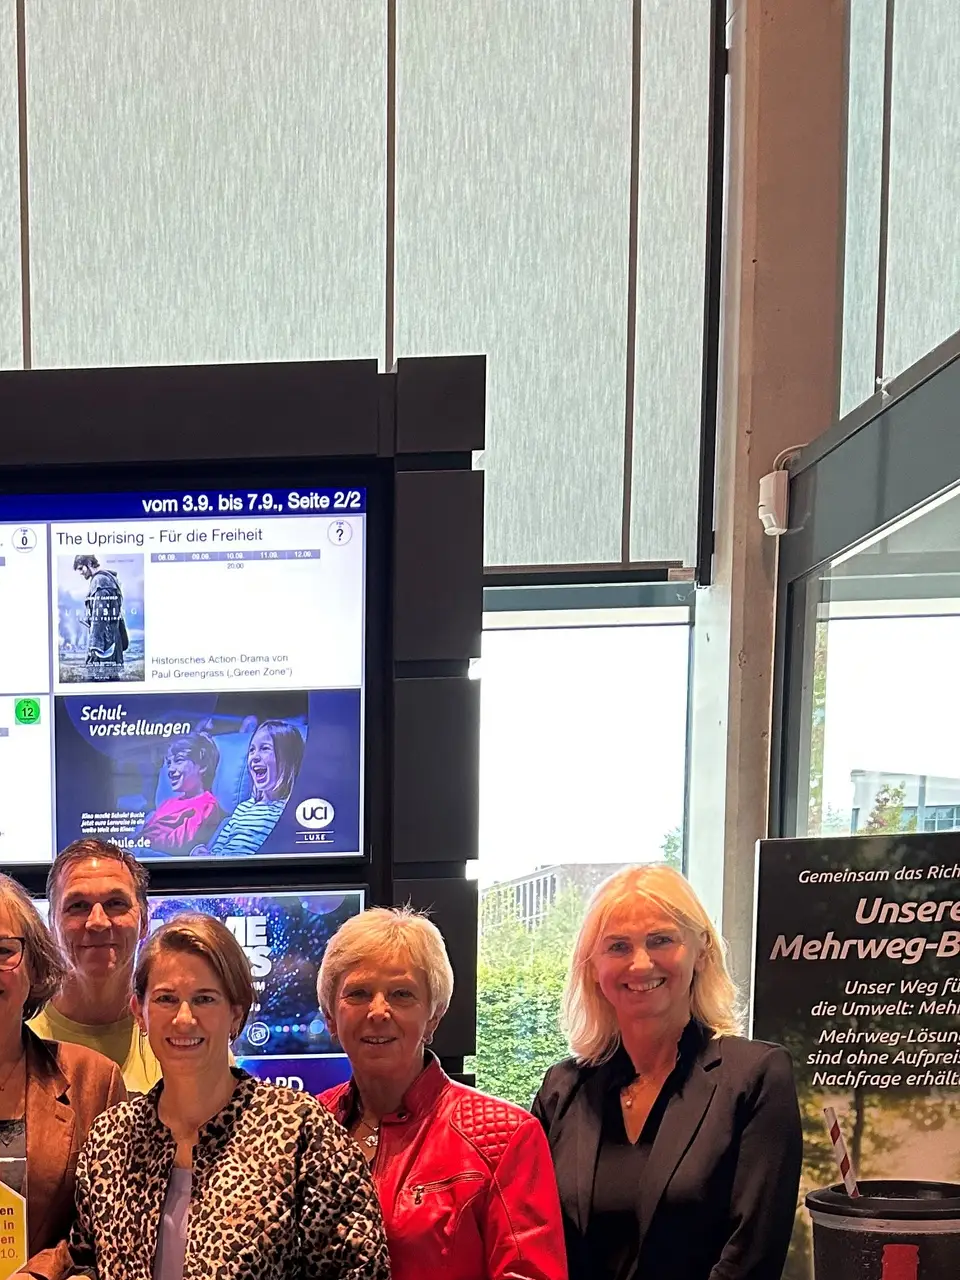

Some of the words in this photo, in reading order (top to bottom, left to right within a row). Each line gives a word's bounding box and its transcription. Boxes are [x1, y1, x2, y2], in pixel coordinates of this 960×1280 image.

[142, 498, 178, 513] vom
[183, 495, 214, 512] 3.9.
[218, 493, 243, 511] bis
[247, 493, 283, 512] 7.9.,
[288, 492, 330, 509] Seite
[333, 490, 361, 508] 2/2
[21, 536, 28, 546] 0
[57, 532, 83, 545] The
[87, 530, 145, 547] Uprising
[159, 529, 182, 543] Für
[187, 528, 207, 542] die
[211, 527, 263, 542] Freiheit
[151, 655, 206, 665] Historisches
[272, 654, 289, 662] von
[151, 669, 171, 679] Paul
[173, 668, 224, 680] Greengrass
[21, 706, 34, 717] 12
[80, 704, 127, 721] Schul-
[89, 721, 191, 738] vorstellungen
[302, 807, 327, 821] UCI
[798, 868, 890, 883] Gemeinsam
[894, 865, 924, 880] das
[845, 980, 895, 995] Unser
[900, 979, 938, 996] Weg
[811, 1001, 837, 1016] die
[842, 1000, 914, 1016] Umwelt:
[819, 1028, 960, 1046] Mehrweg-Lösun
[807, 1050, 843, 1065] sind
[847, 1050, 889, 1065] ohne
[812, 1071, 901, 1089] Nachfrage
[906, 1070, 960, 1086] erhält
[3, 1221, 14, 1231] in
